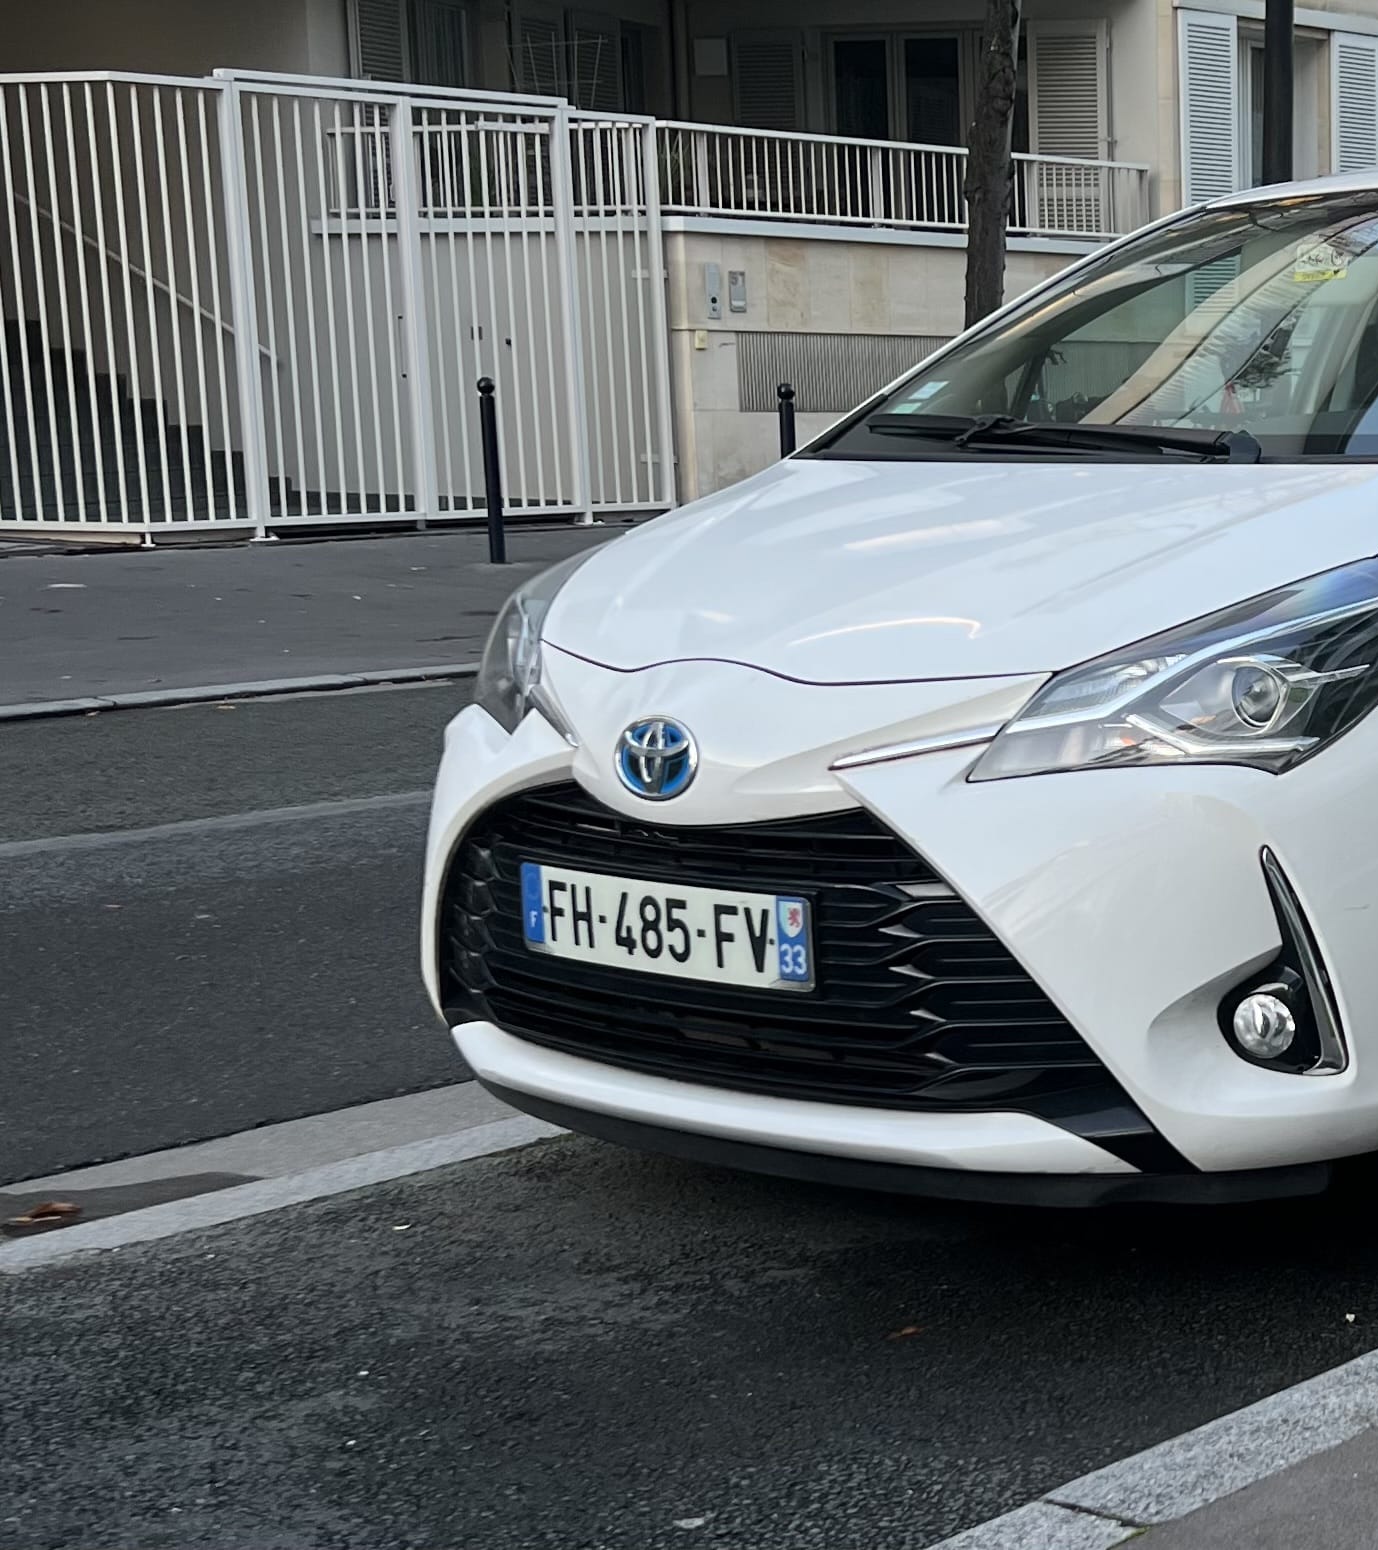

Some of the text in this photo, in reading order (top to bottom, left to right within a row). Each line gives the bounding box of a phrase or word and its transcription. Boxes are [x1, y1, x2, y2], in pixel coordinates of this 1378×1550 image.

[529, 912, 538, 928] F
[548, 879, 770, 973] FH-485-FV
[779, 943, 807, 975] 33
